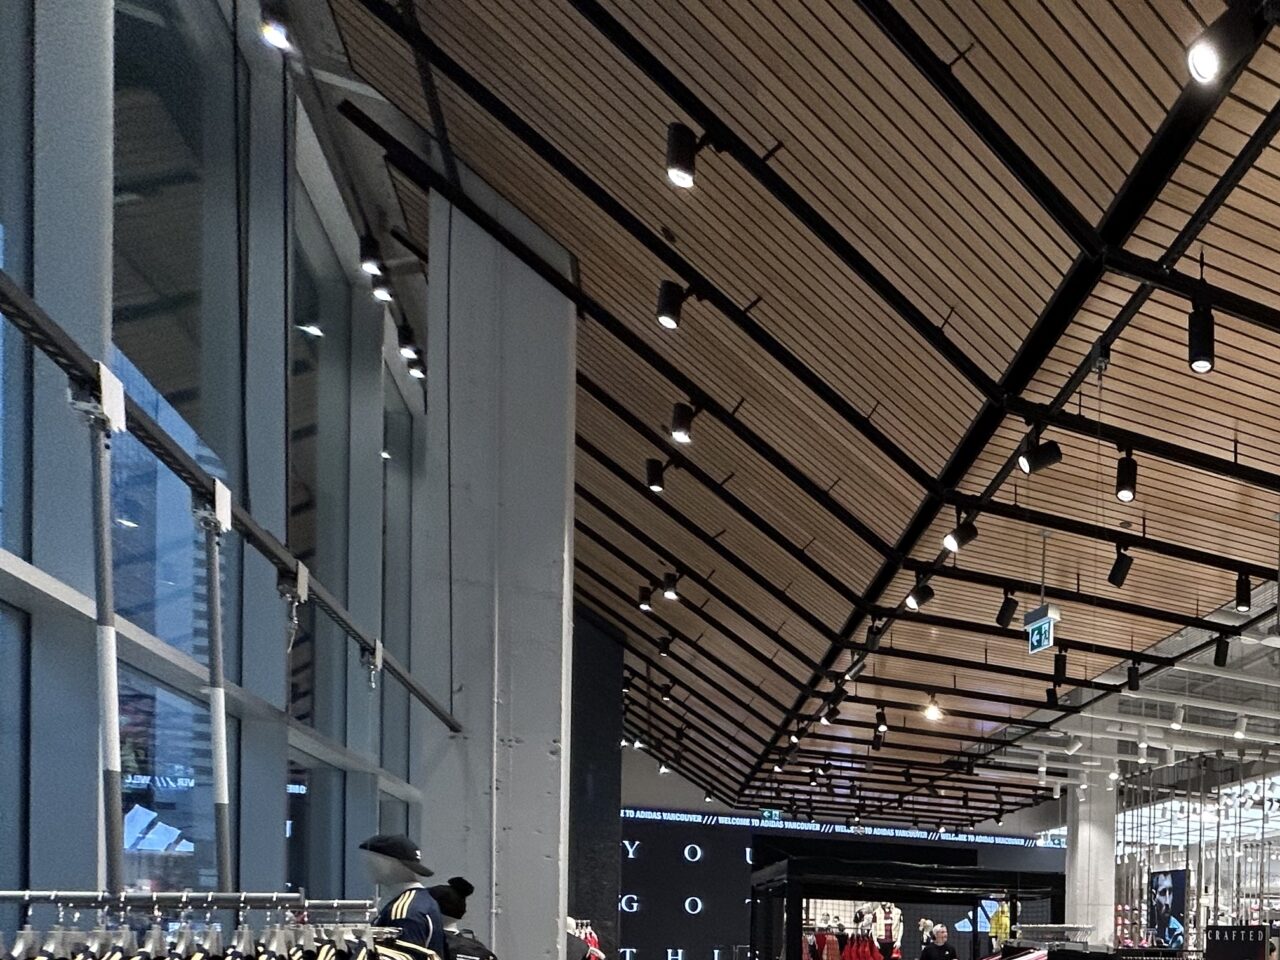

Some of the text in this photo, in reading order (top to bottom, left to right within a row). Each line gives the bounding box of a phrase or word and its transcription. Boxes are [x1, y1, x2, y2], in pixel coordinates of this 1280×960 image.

[625, 810, 635, 818] TO
[636, 811, 662, 820] ADIDAS
[662, 812, 703, 822] VANCOUVER
[718, 816, 750, 826] WELCOME
[751, 819, 760, 827] TO
[760, 819, 784, 829] ADIDAS
[784, 821, 821, 831] VANCOUVER
[864, 826, 873, 835] TO
[873, 828, 895, 837] ADIDAS
[895, 829, 928, 839] VANCOUVER
[620, 894, 754, 915] GO
[1207, 929, 1264, 942] CRAFTED
